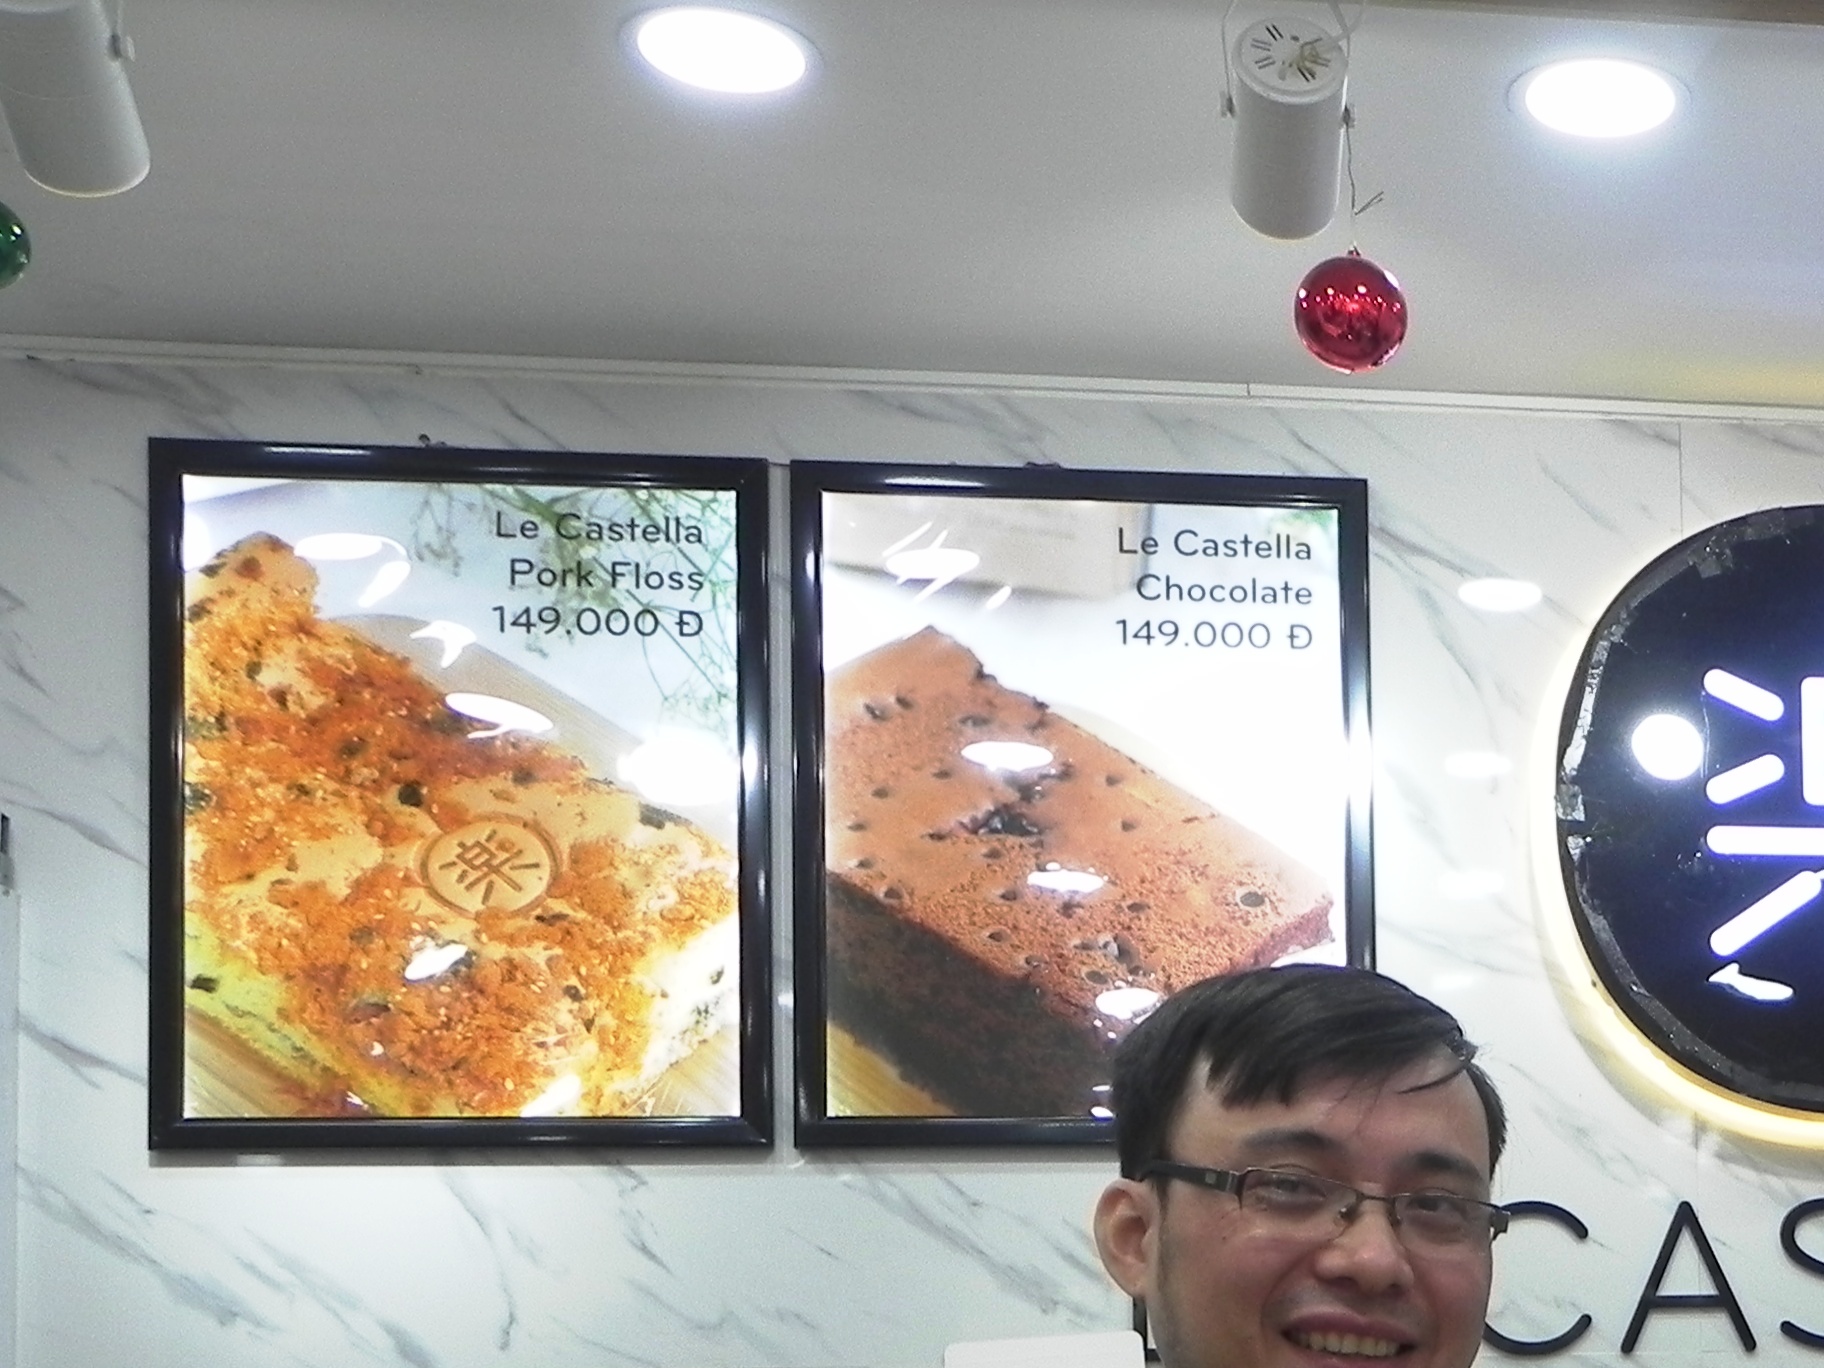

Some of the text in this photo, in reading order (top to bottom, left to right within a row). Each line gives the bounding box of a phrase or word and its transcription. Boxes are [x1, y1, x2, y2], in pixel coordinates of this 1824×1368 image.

[496, 511, 704, 545] Le Castella
[1118, 527, 1312, 561] Le Castella
[509, 558, 705, 592] Pork Floss
[1135, 573, 1313, 605] Chocolate
[492, 604, 660, 638] 149.000
[1115, 618, 1271, 650] 149.000
